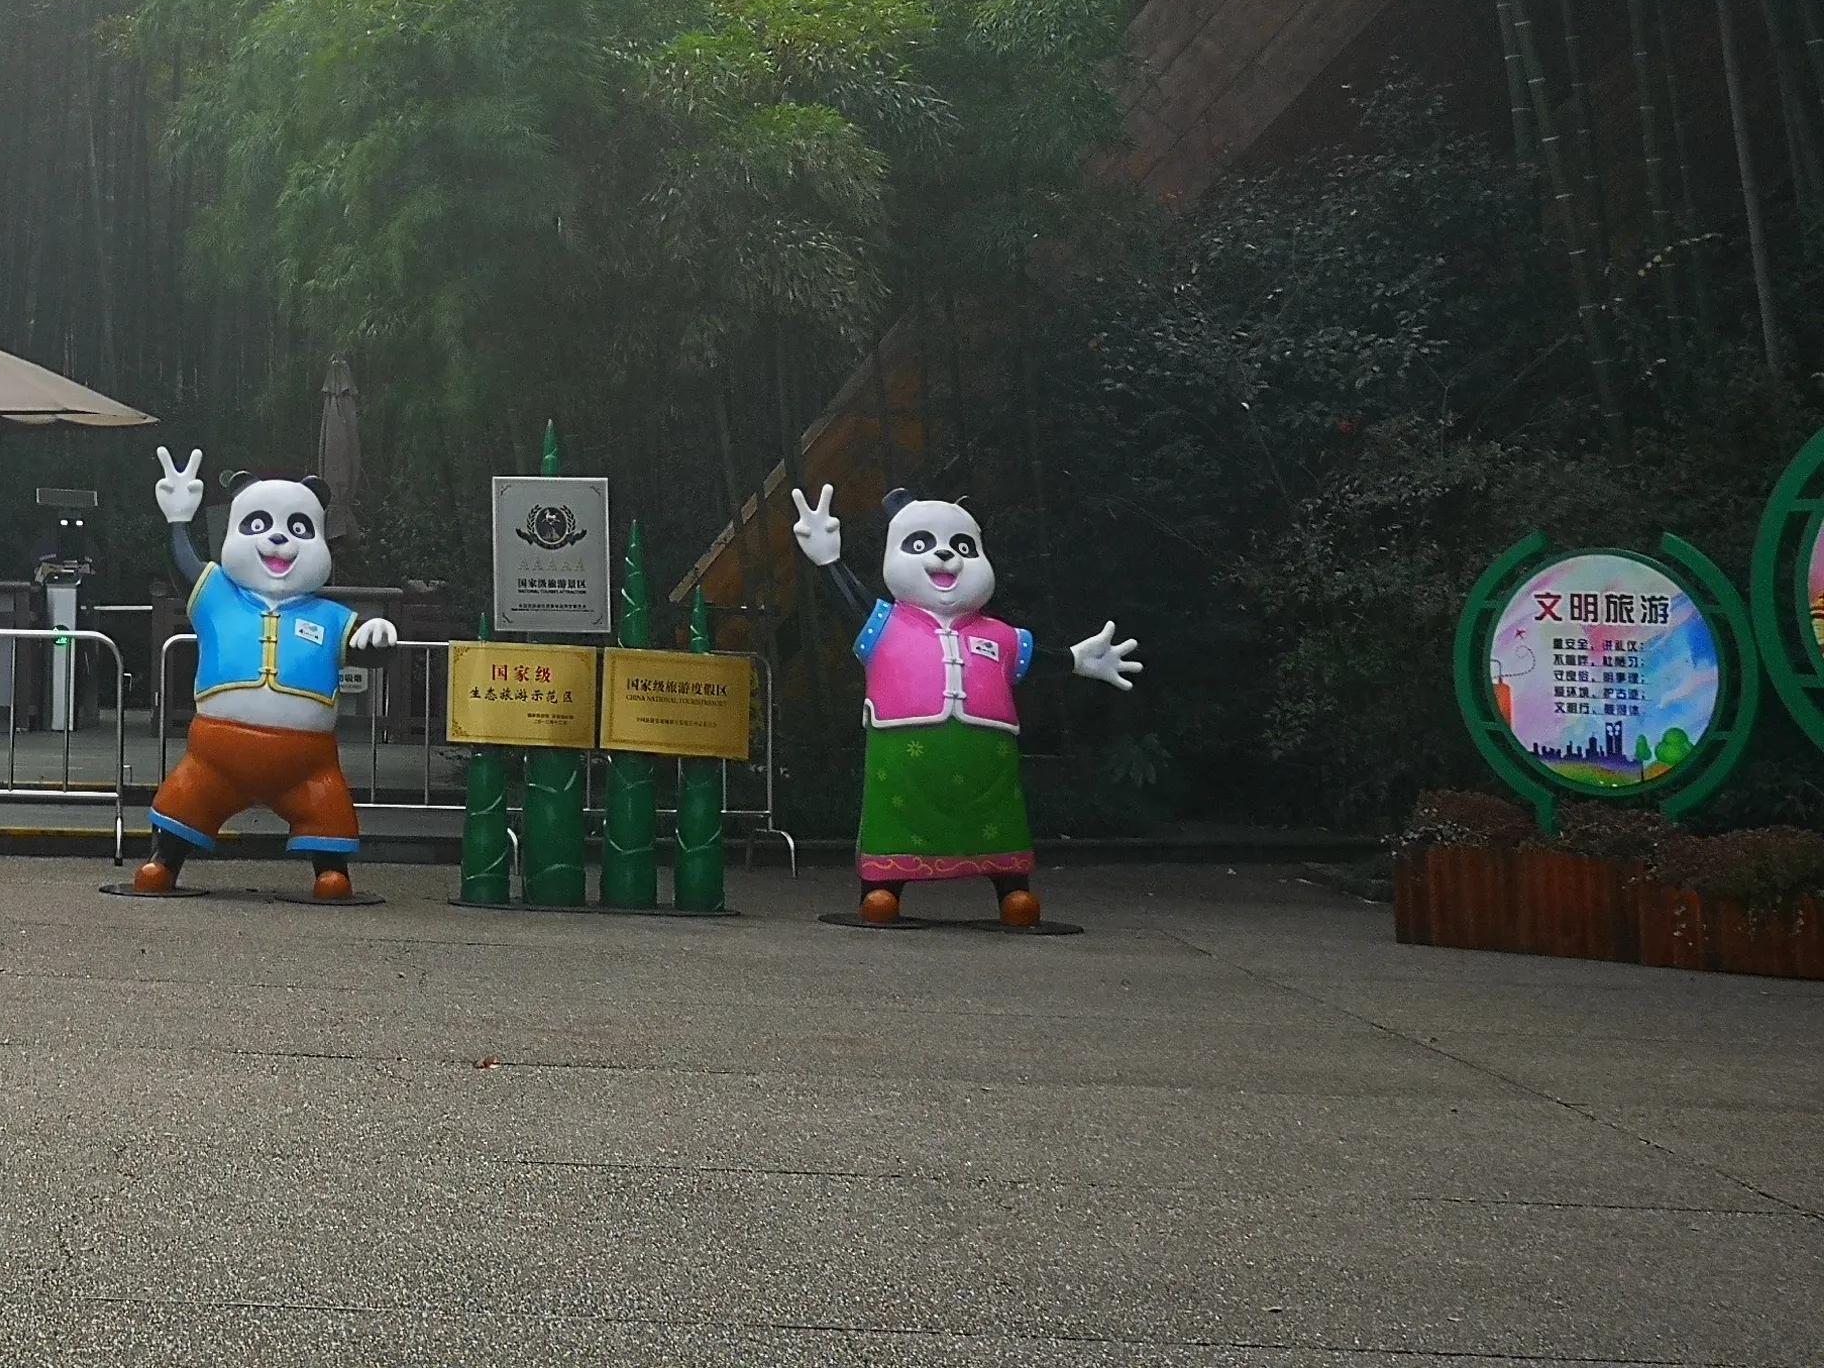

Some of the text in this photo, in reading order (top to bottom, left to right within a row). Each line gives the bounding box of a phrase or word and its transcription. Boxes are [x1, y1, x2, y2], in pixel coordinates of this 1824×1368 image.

[1534, 592, 1670, 624] 文明旅游
[492, 664, 551, 683] 国家级
[470, 686, 574, 704] 生态旅游示范区
[626, 678, 728, 697] 国家级旅游度假区
